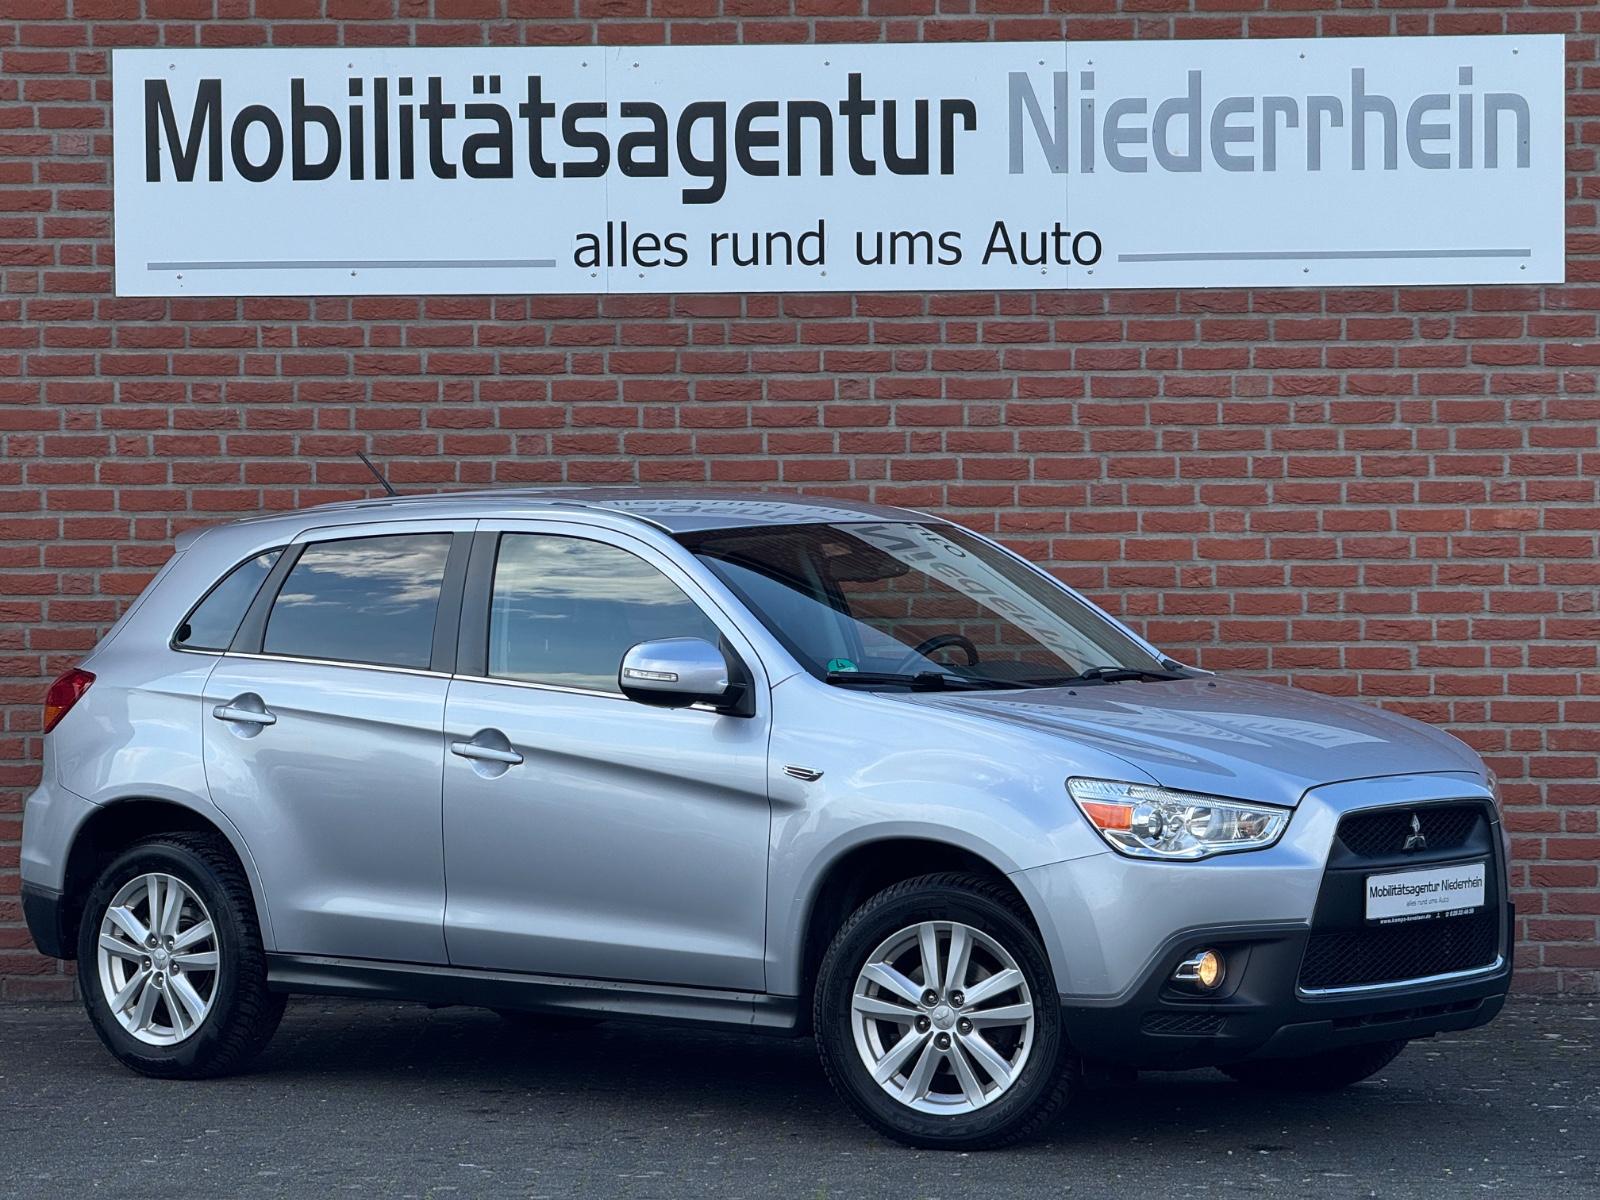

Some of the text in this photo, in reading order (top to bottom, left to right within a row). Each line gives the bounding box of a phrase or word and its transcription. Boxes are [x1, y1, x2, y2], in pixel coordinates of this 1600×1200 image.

[144, 66, 1531, 205] Mobilitätsagentur Niederrhein
[574, 219, 1102, 268] alles rund ums Auto
[1369, 876, 1482, 899] Mobilitätsagentur Niederrhein
